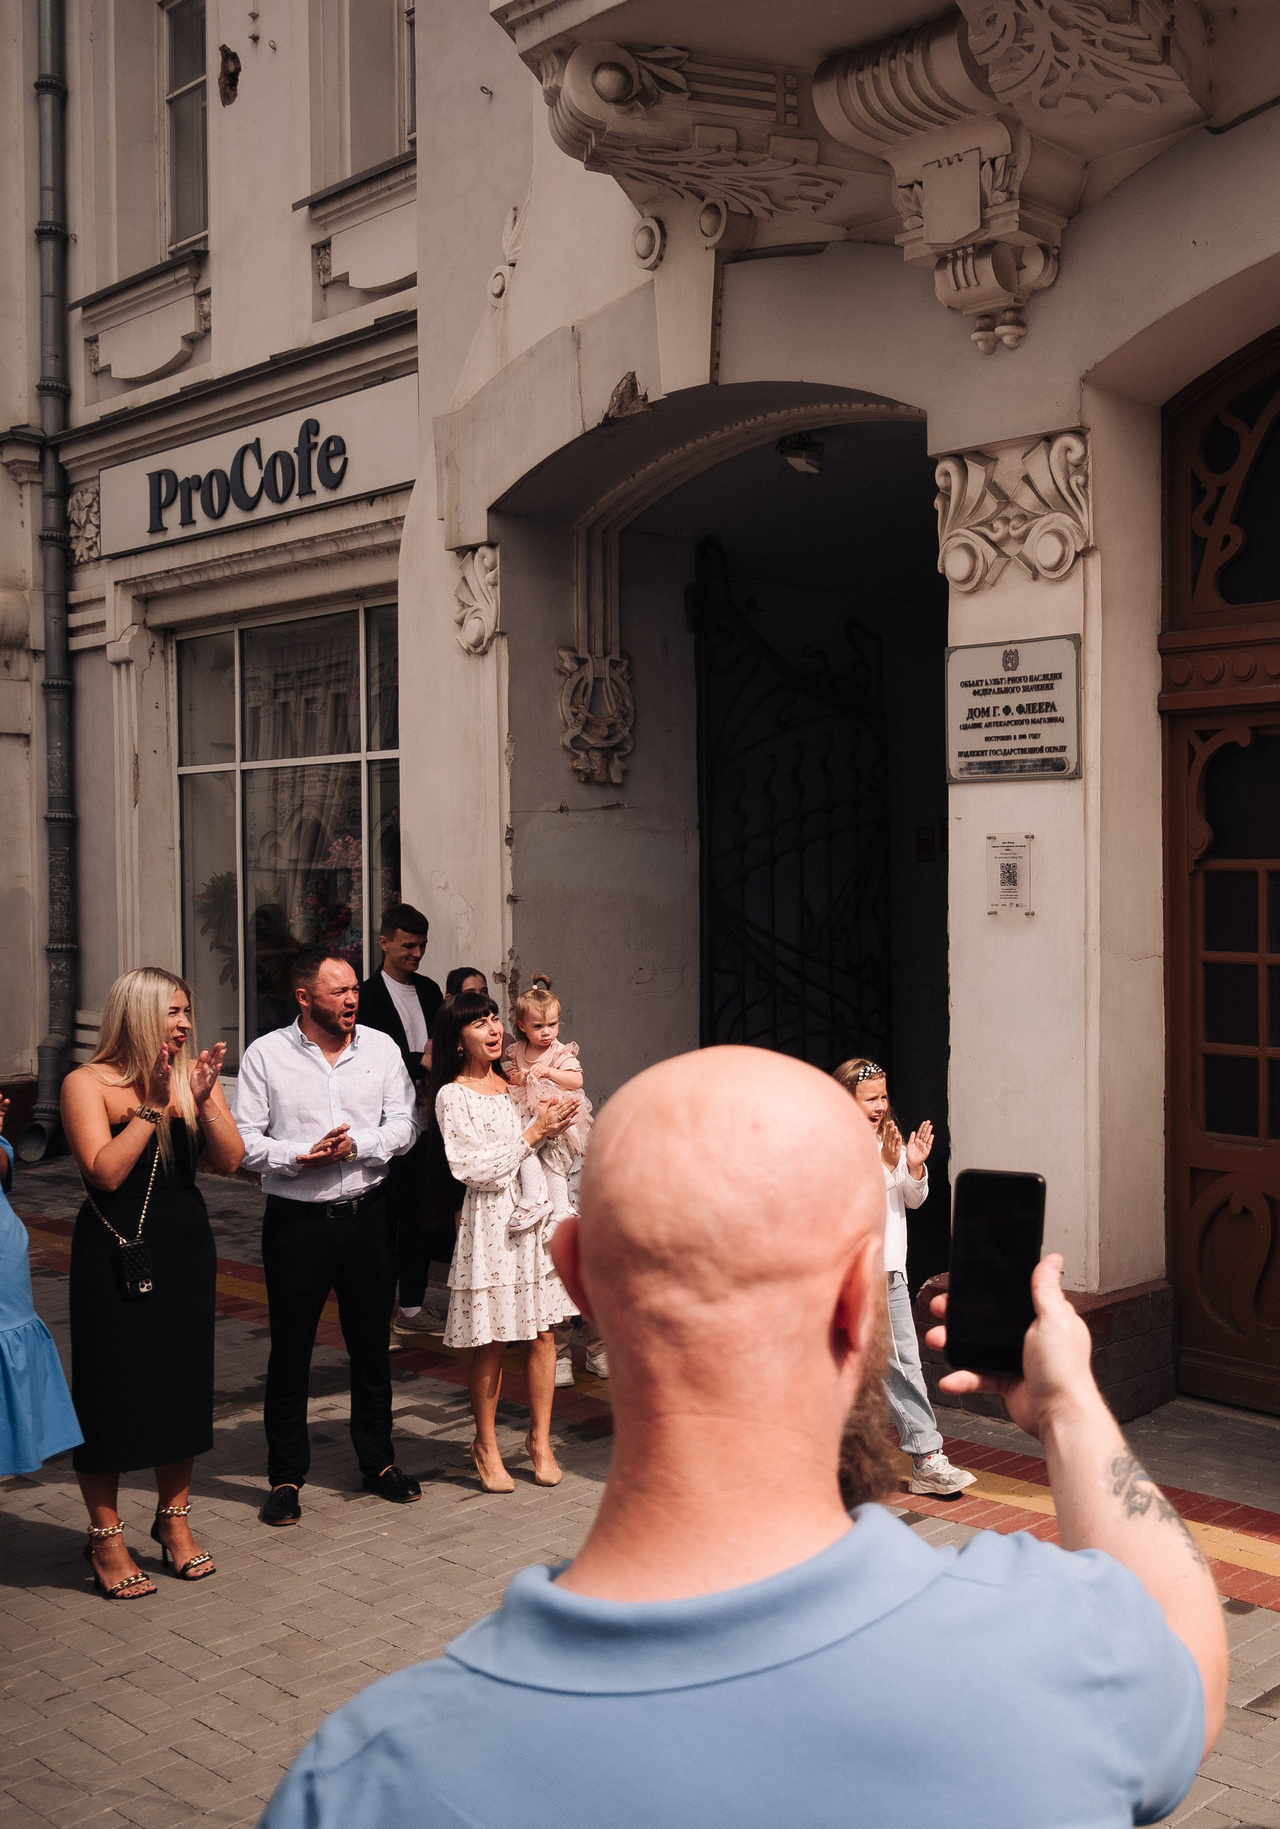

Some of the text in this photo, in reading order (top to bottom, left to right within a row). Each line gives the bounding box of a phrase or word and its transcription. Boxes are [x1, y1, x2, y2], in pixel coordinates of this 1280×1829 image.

[145, 418, 348, 533] ProCofe
[1029, 672, 1062, 682] НАСЛЕДИЯ
[972, 683, 1054, 697] ФЕДЕРАЛЬНОГО ЗНАЧЕНИЯ
[966, 701, 1057, 720] ДОМ Г. Ф. ФЛЕЕРА
